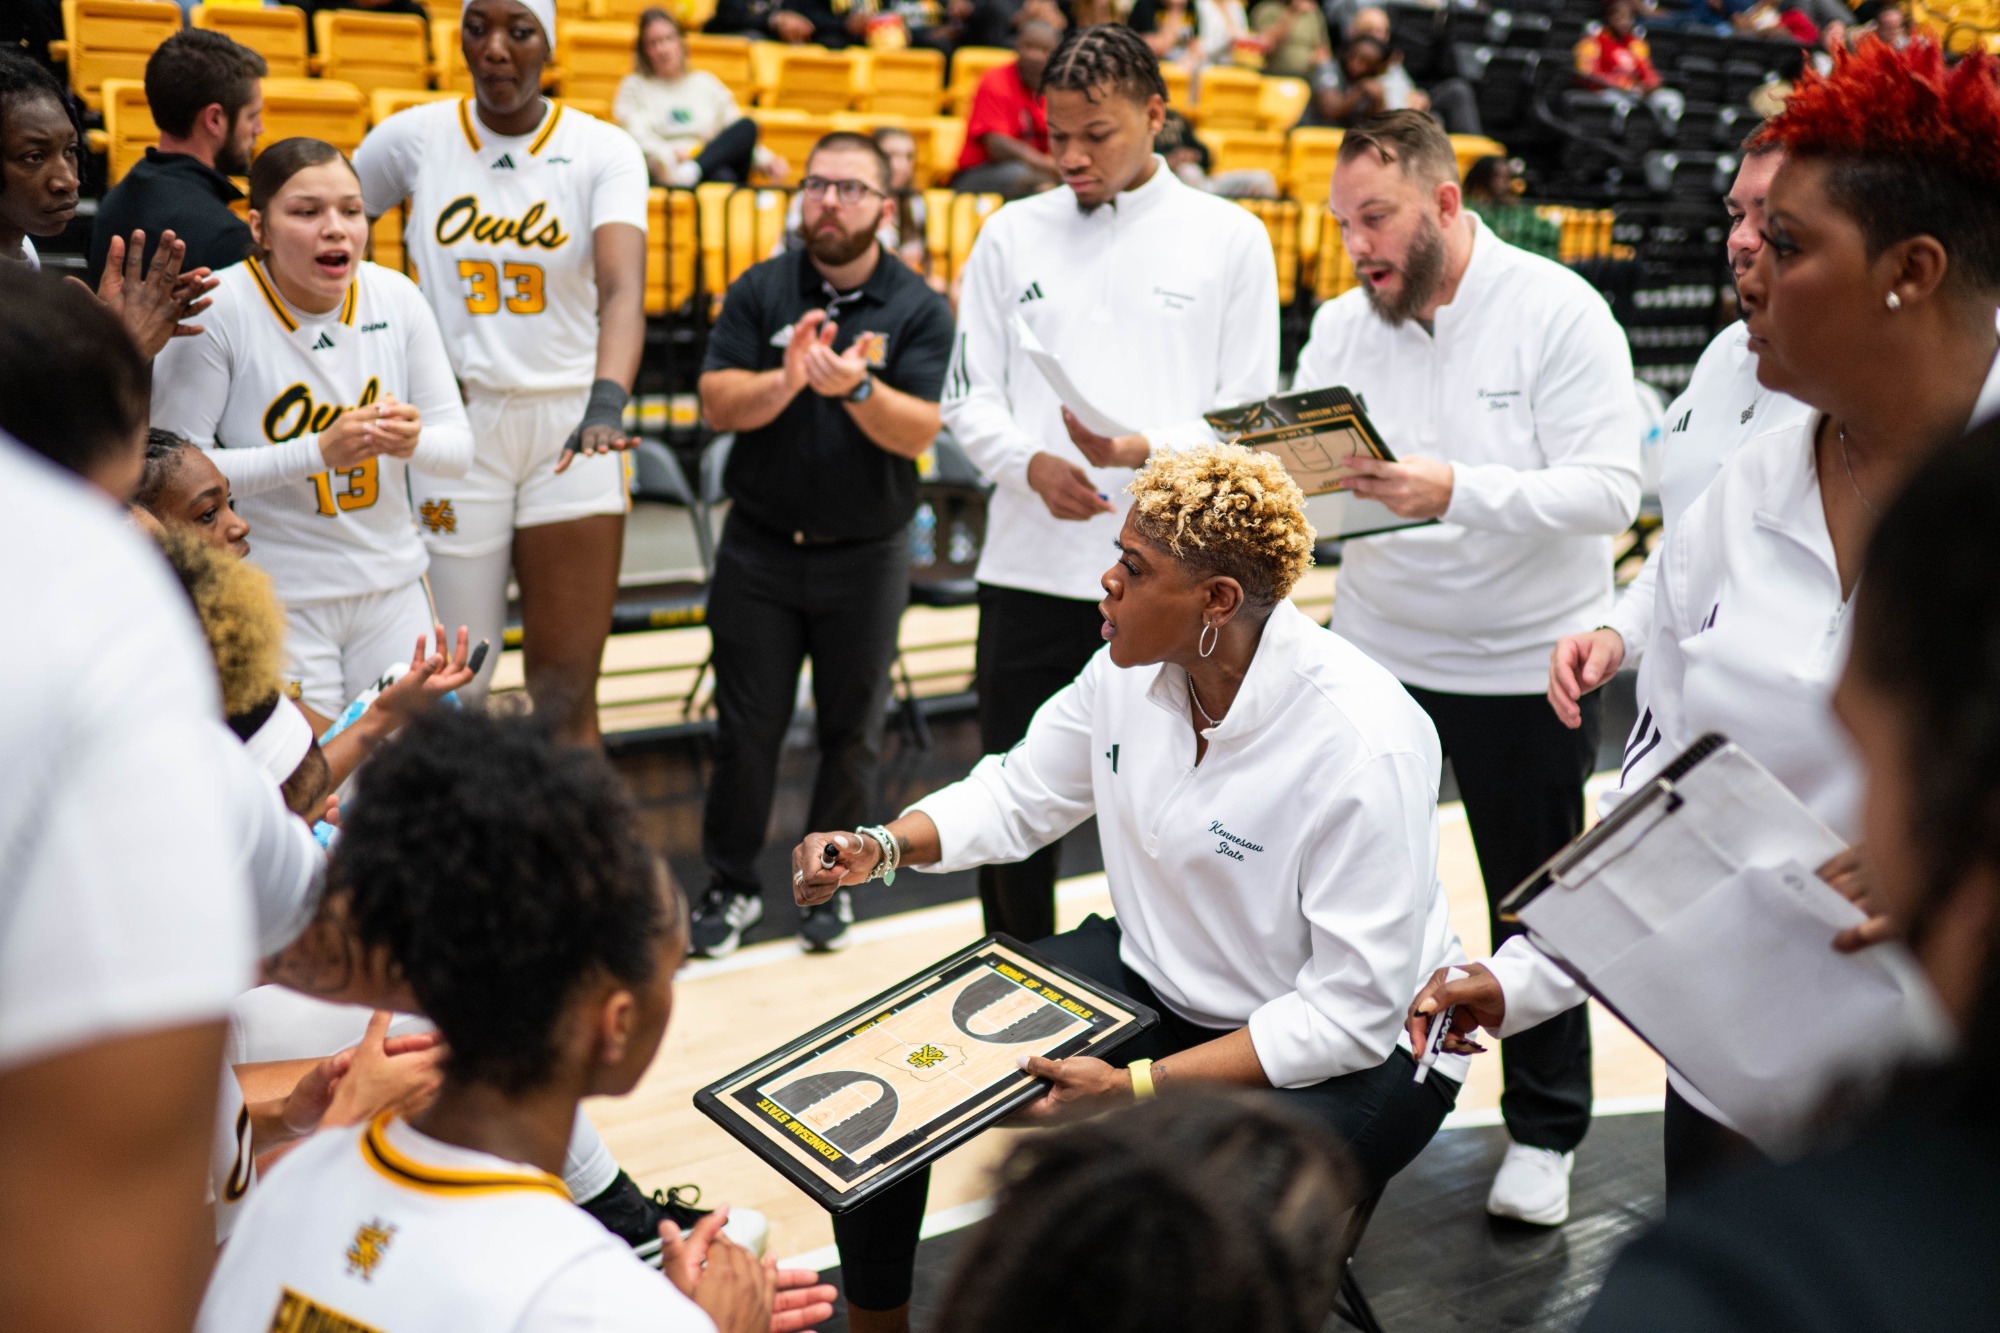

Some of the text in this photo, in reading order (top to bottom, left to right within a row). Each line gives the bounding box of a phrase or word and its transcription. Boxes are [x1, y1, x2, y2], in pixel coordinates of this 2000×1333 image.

[436, 195, 569, 250] Owls
[457, 258, 547, 317] 33
[1276, 427, 1314, 440] OWLS
[307, 456, 380, 517] 13
[1208, 820, 1264, 852] Kennesaw
[1215, 841, 1245, 861] State
[996, 963, 1094, 1019] HOME OF THE OWLS
[756, 1098, 843, 1162] KENNESAW STATE
